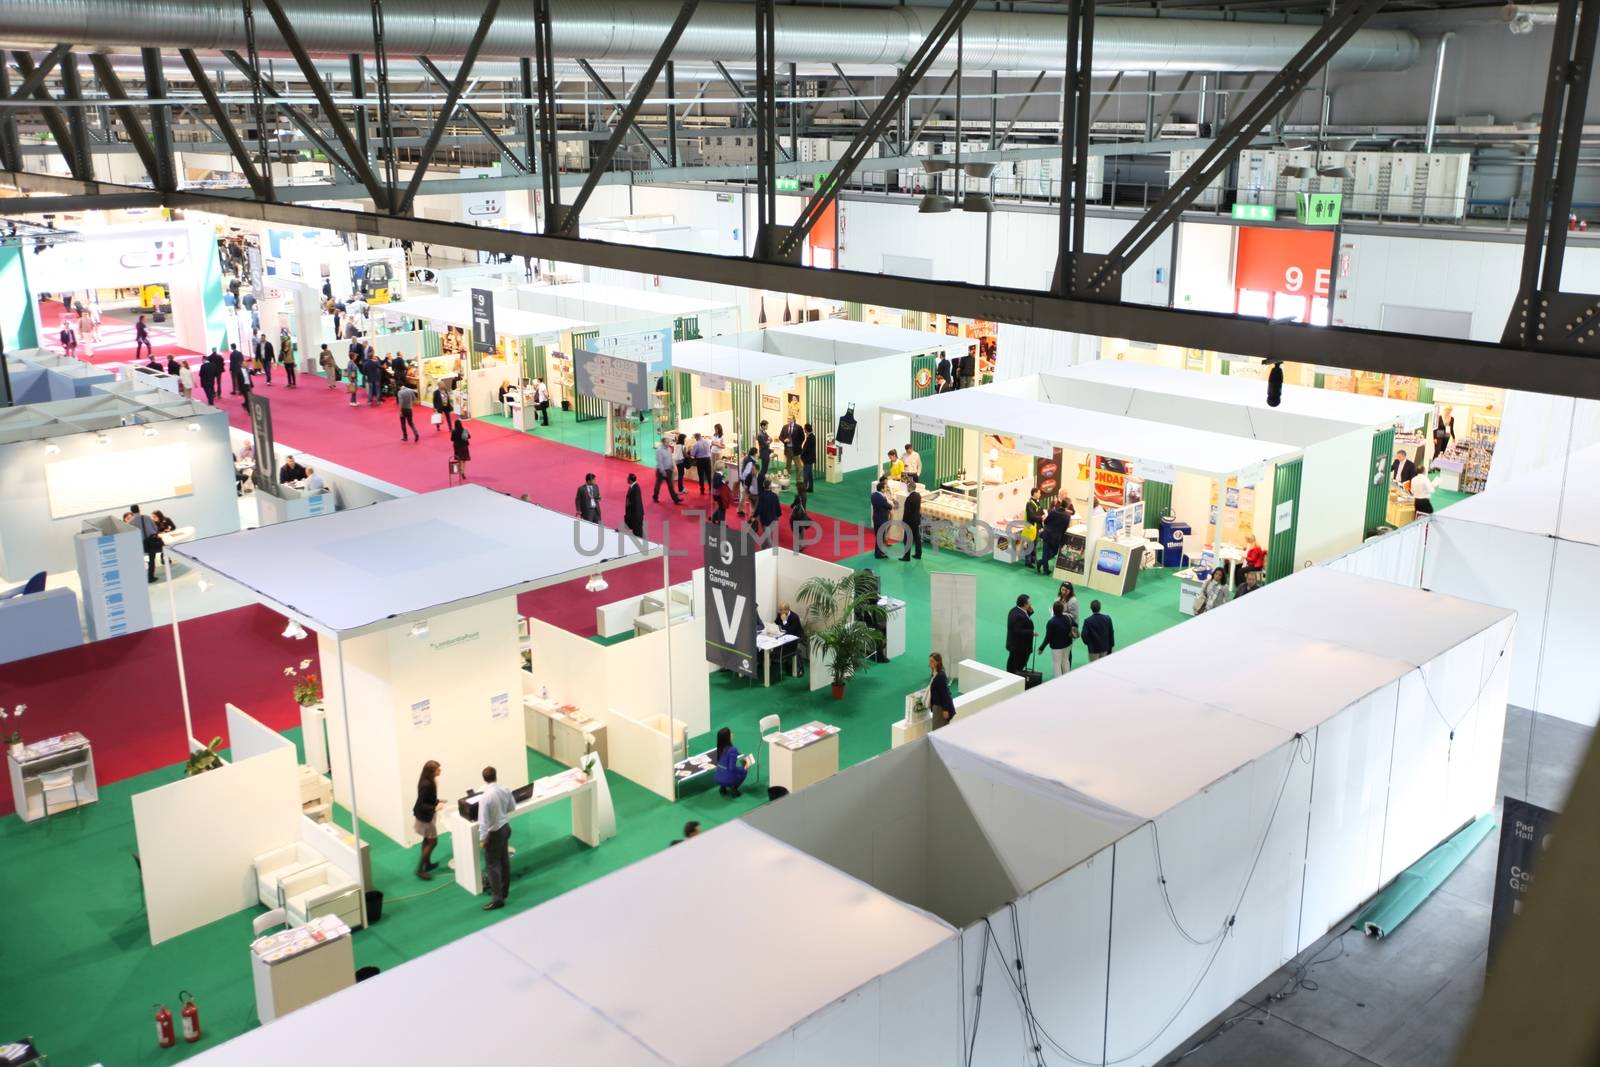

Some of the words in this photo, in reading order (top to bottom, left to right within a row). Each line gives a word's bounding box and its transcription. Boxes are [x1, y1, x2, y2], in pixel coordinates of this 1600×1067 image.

[1285, 266, 1304, 292] 9
[1314, 268, 1331, 294] E
[478, 294, 485, 306] 9
[475, 317, 489, 343] T
[720, 540, 734, 565] 9
[709, 566, 730, 578] Corsia
[709, 574, 744, 590] Gangway
[712, 587, 747, 646] V
[1515, 821, 1534, 833] Pad
[1514, 830, 1533, 841] Hall
